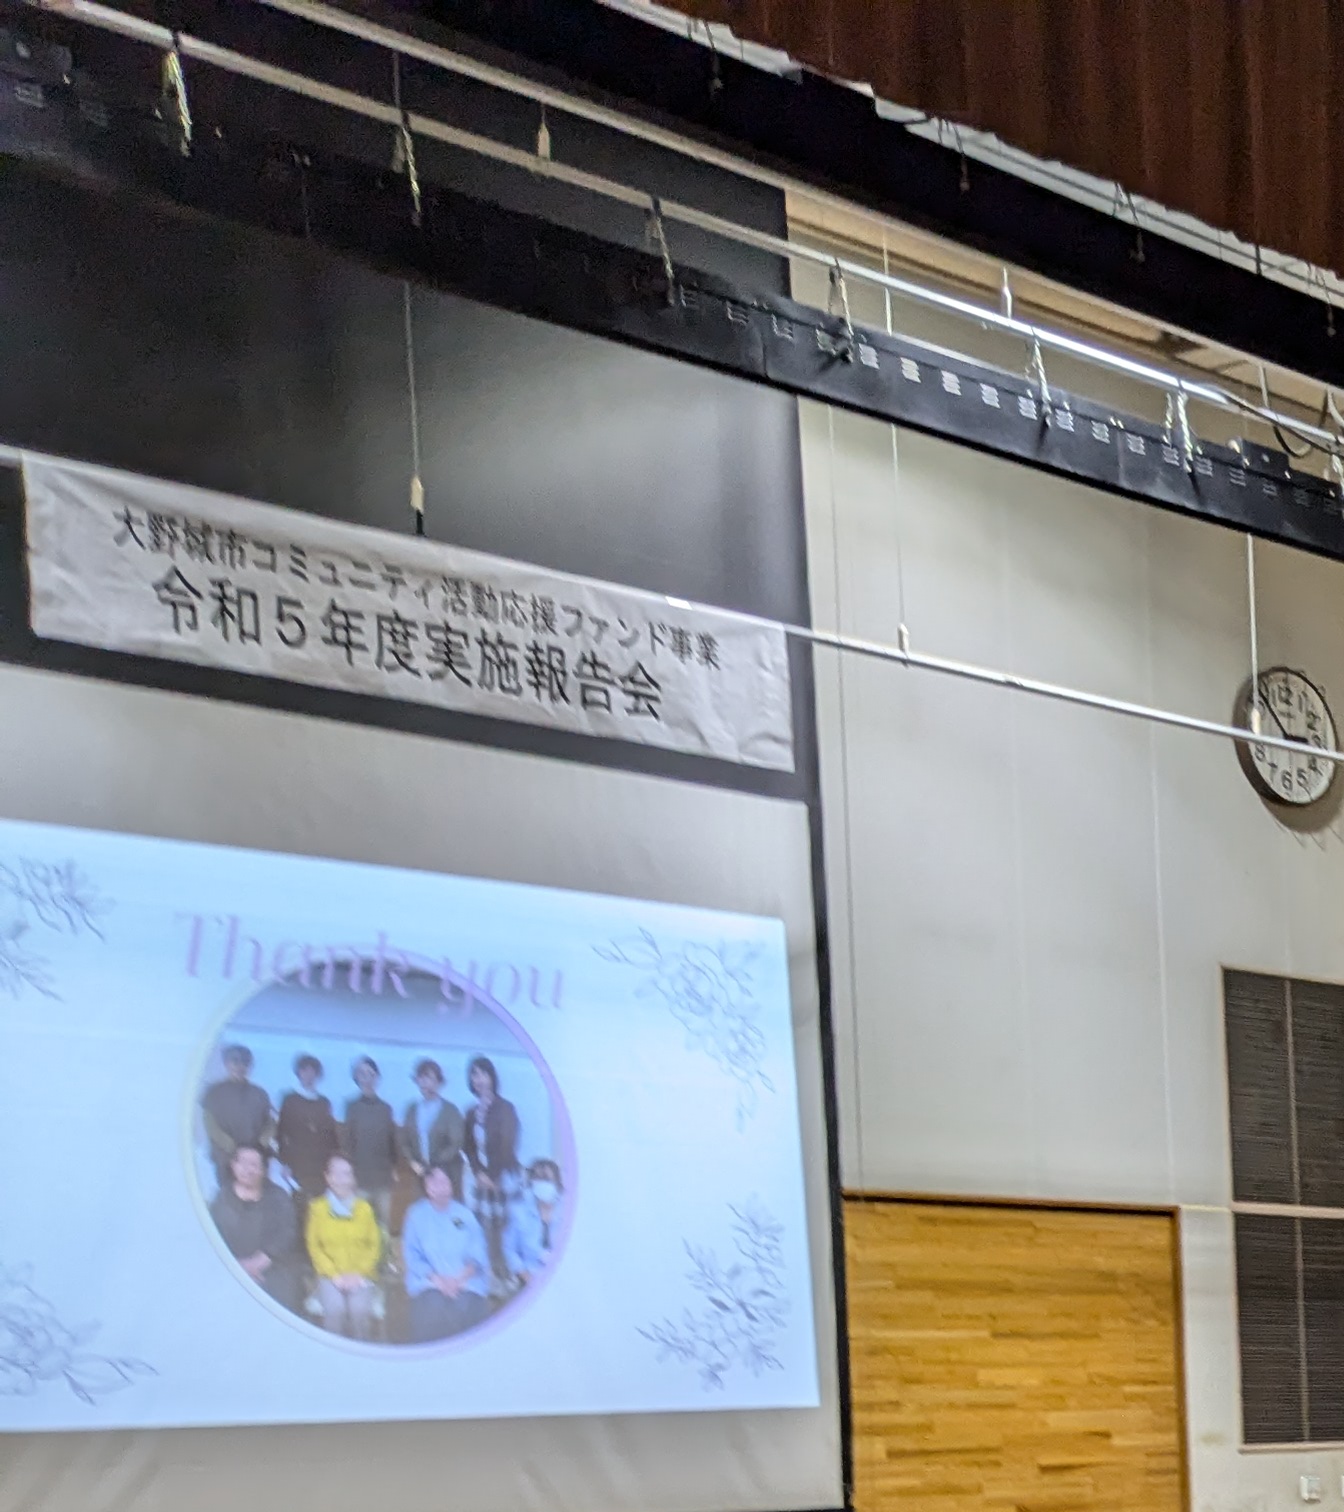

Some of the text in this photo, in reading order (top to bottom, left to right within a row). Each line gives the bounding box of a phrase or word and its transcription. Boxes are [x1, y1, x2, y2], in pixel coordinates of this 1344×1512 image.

[152, 565, 663, 721] 令和5年度実施報告会
[173, 912, 564, 1019] Thank you
